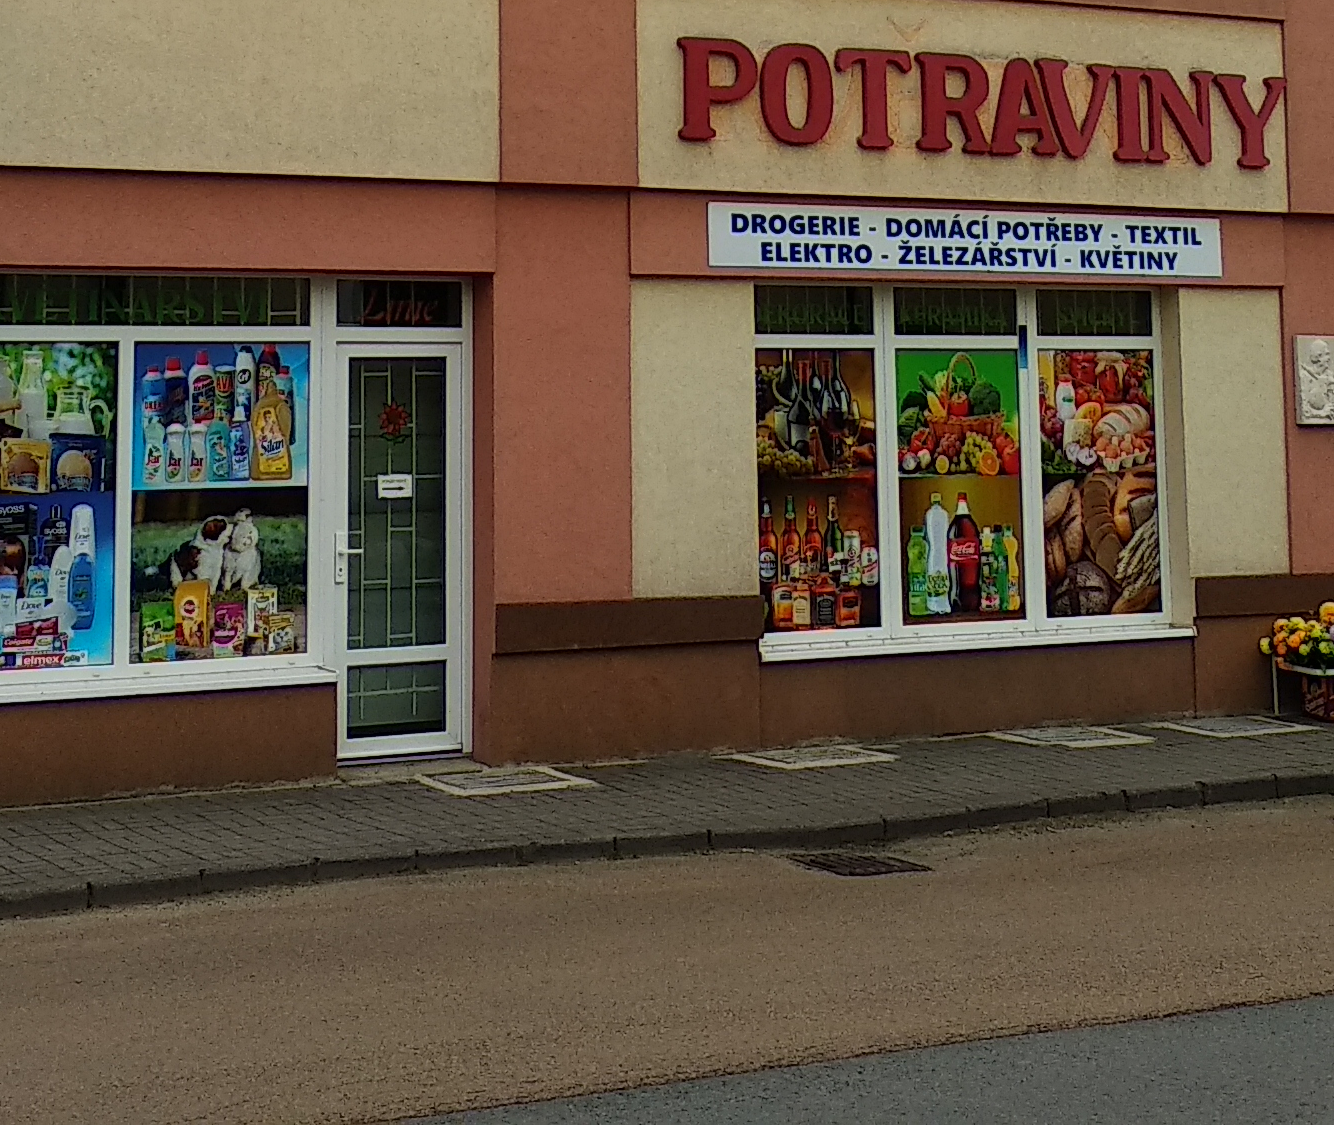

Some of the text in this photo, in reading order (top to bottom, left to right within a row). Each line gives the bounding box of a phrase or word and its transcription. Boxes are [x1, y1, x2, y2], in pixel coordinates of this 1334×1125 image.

[677, 37, 1287, 169] POTRAVINY
[730, 213, 861, 236] DROGERIE
[885, 214, 990, 240] DOMÁCÍ
[996, 217, 1104, 243] POTŘEBY
[1124, 225, 1203, 246] TEXTIL
[760, 242, 873, 264] ELEKTRO
[897, 240, 1057, 268] ŽELEZÁŘSTVÍ
[1079, 245, 1179, 271] KVĚTINY
[23, 655, 60, 665] elmex
